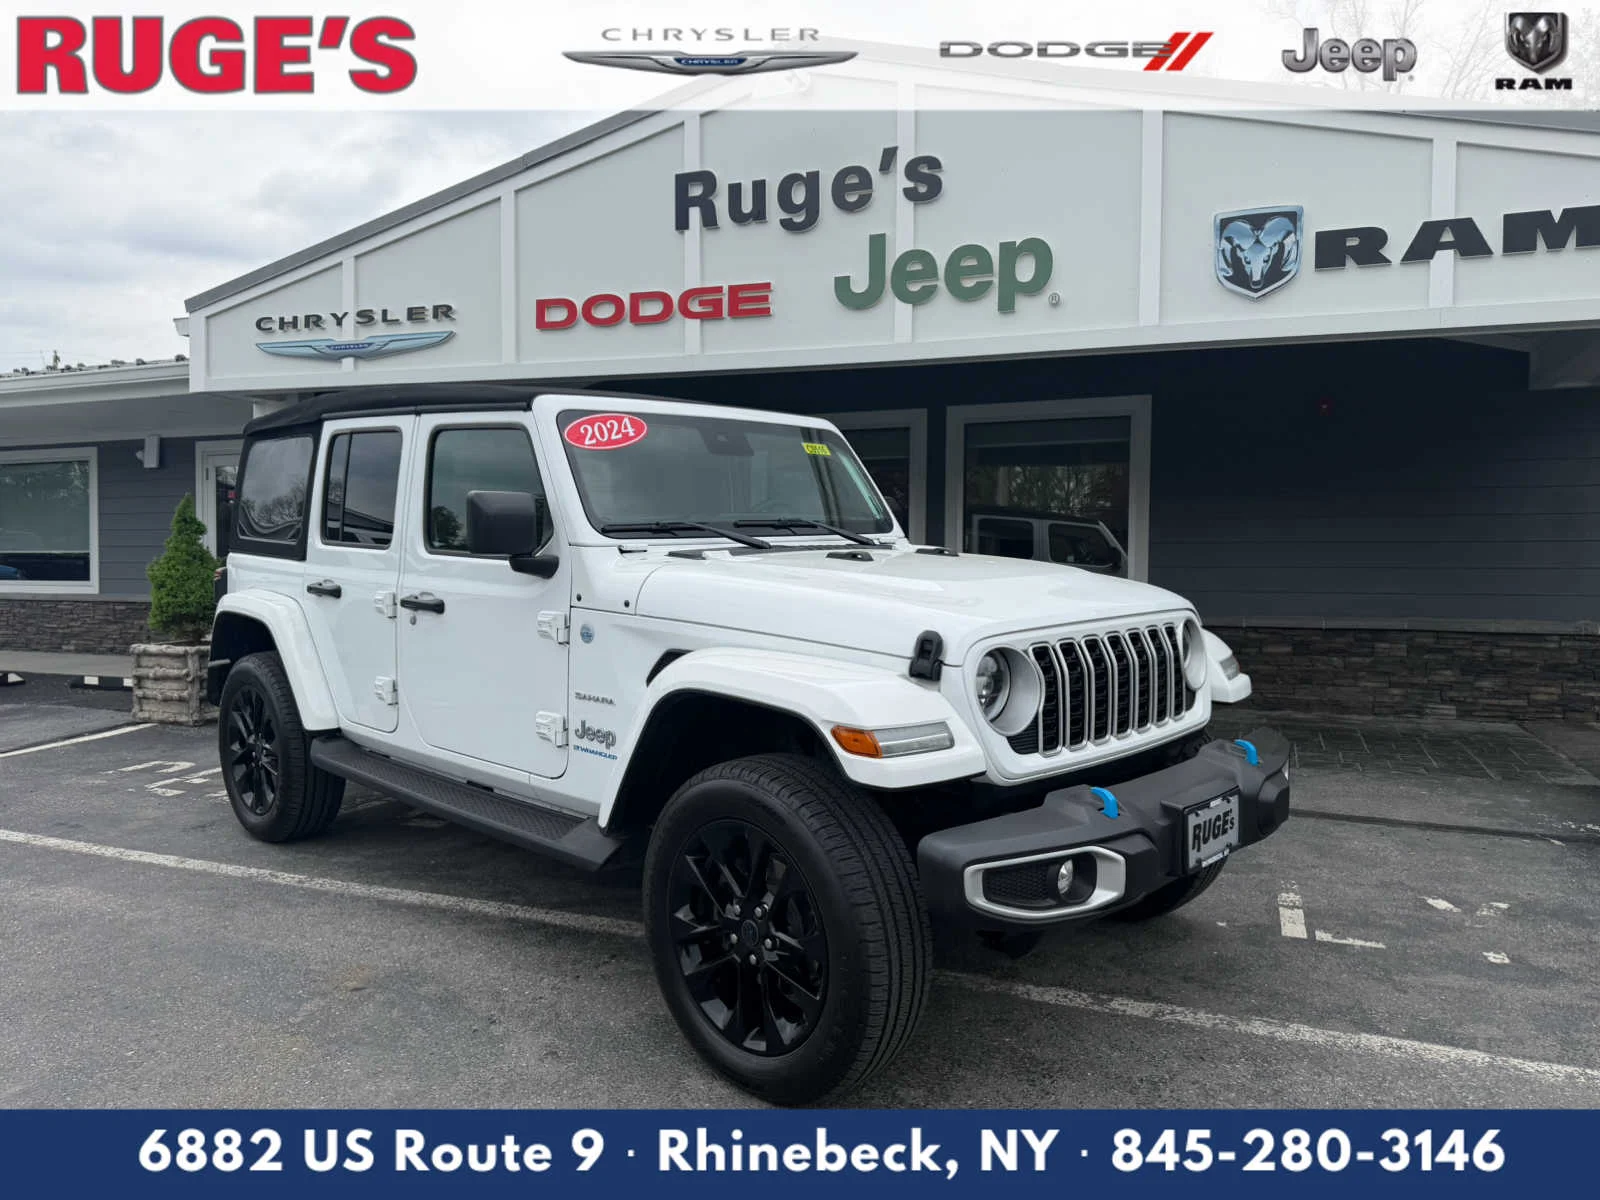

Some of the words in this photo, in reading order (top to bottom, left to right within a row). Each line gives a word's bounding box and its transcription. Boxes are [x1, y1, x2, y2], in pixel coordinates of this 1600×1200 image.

[674, 146, 944, 232] Ruge's
[1314, 205, 1600, 272] RAM
[834, 233, 1054, 313] Jeep
[255, 303, 456, 332] CHRYSLER
[535, 281, 774, 330] DODGE
[579, 416, 636, 446] 2024
[574, 719, 617, 750] Jeep
